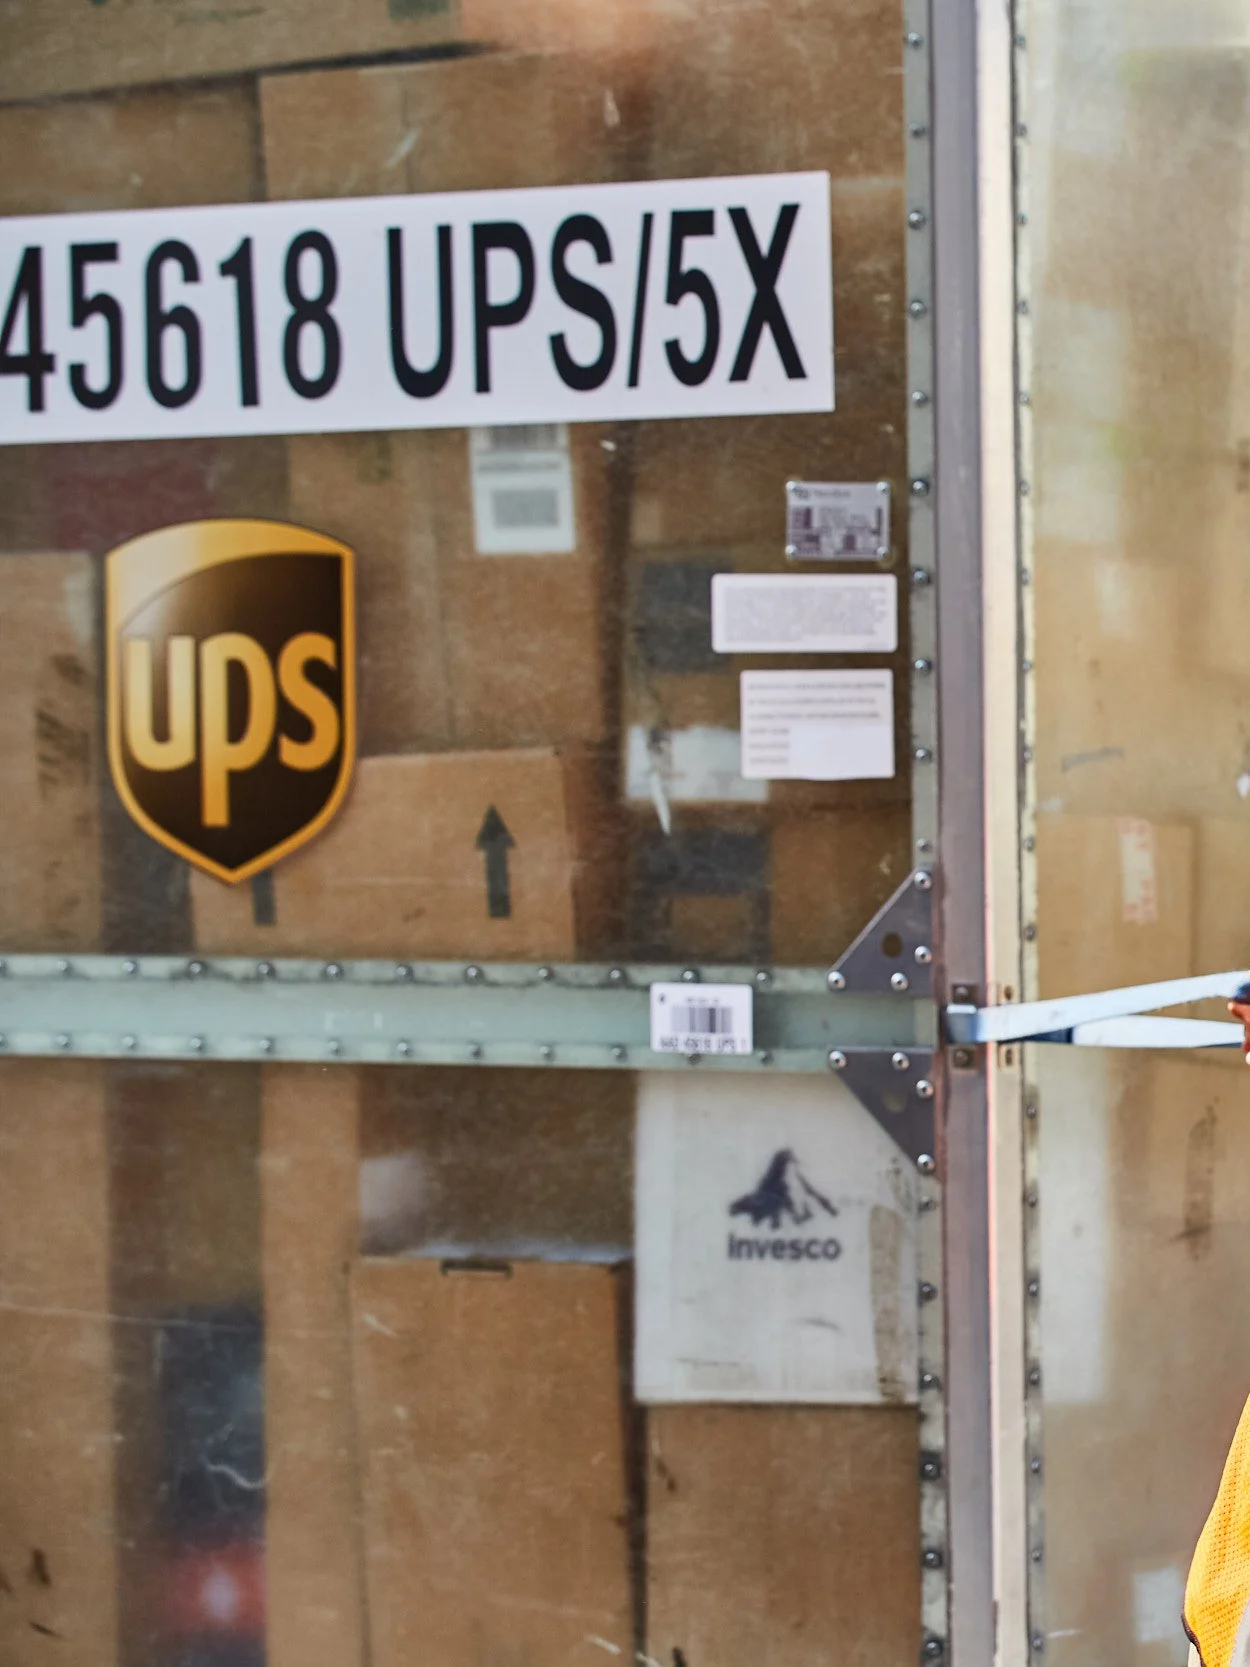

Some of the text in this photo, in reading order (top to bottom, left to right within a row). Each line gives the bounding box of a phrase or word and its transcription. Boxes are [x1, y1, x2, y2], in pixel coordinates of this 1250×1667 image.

[0, 202, 808, 414] 45618 UPS/5X
[125, 631, 341, 828] ups
